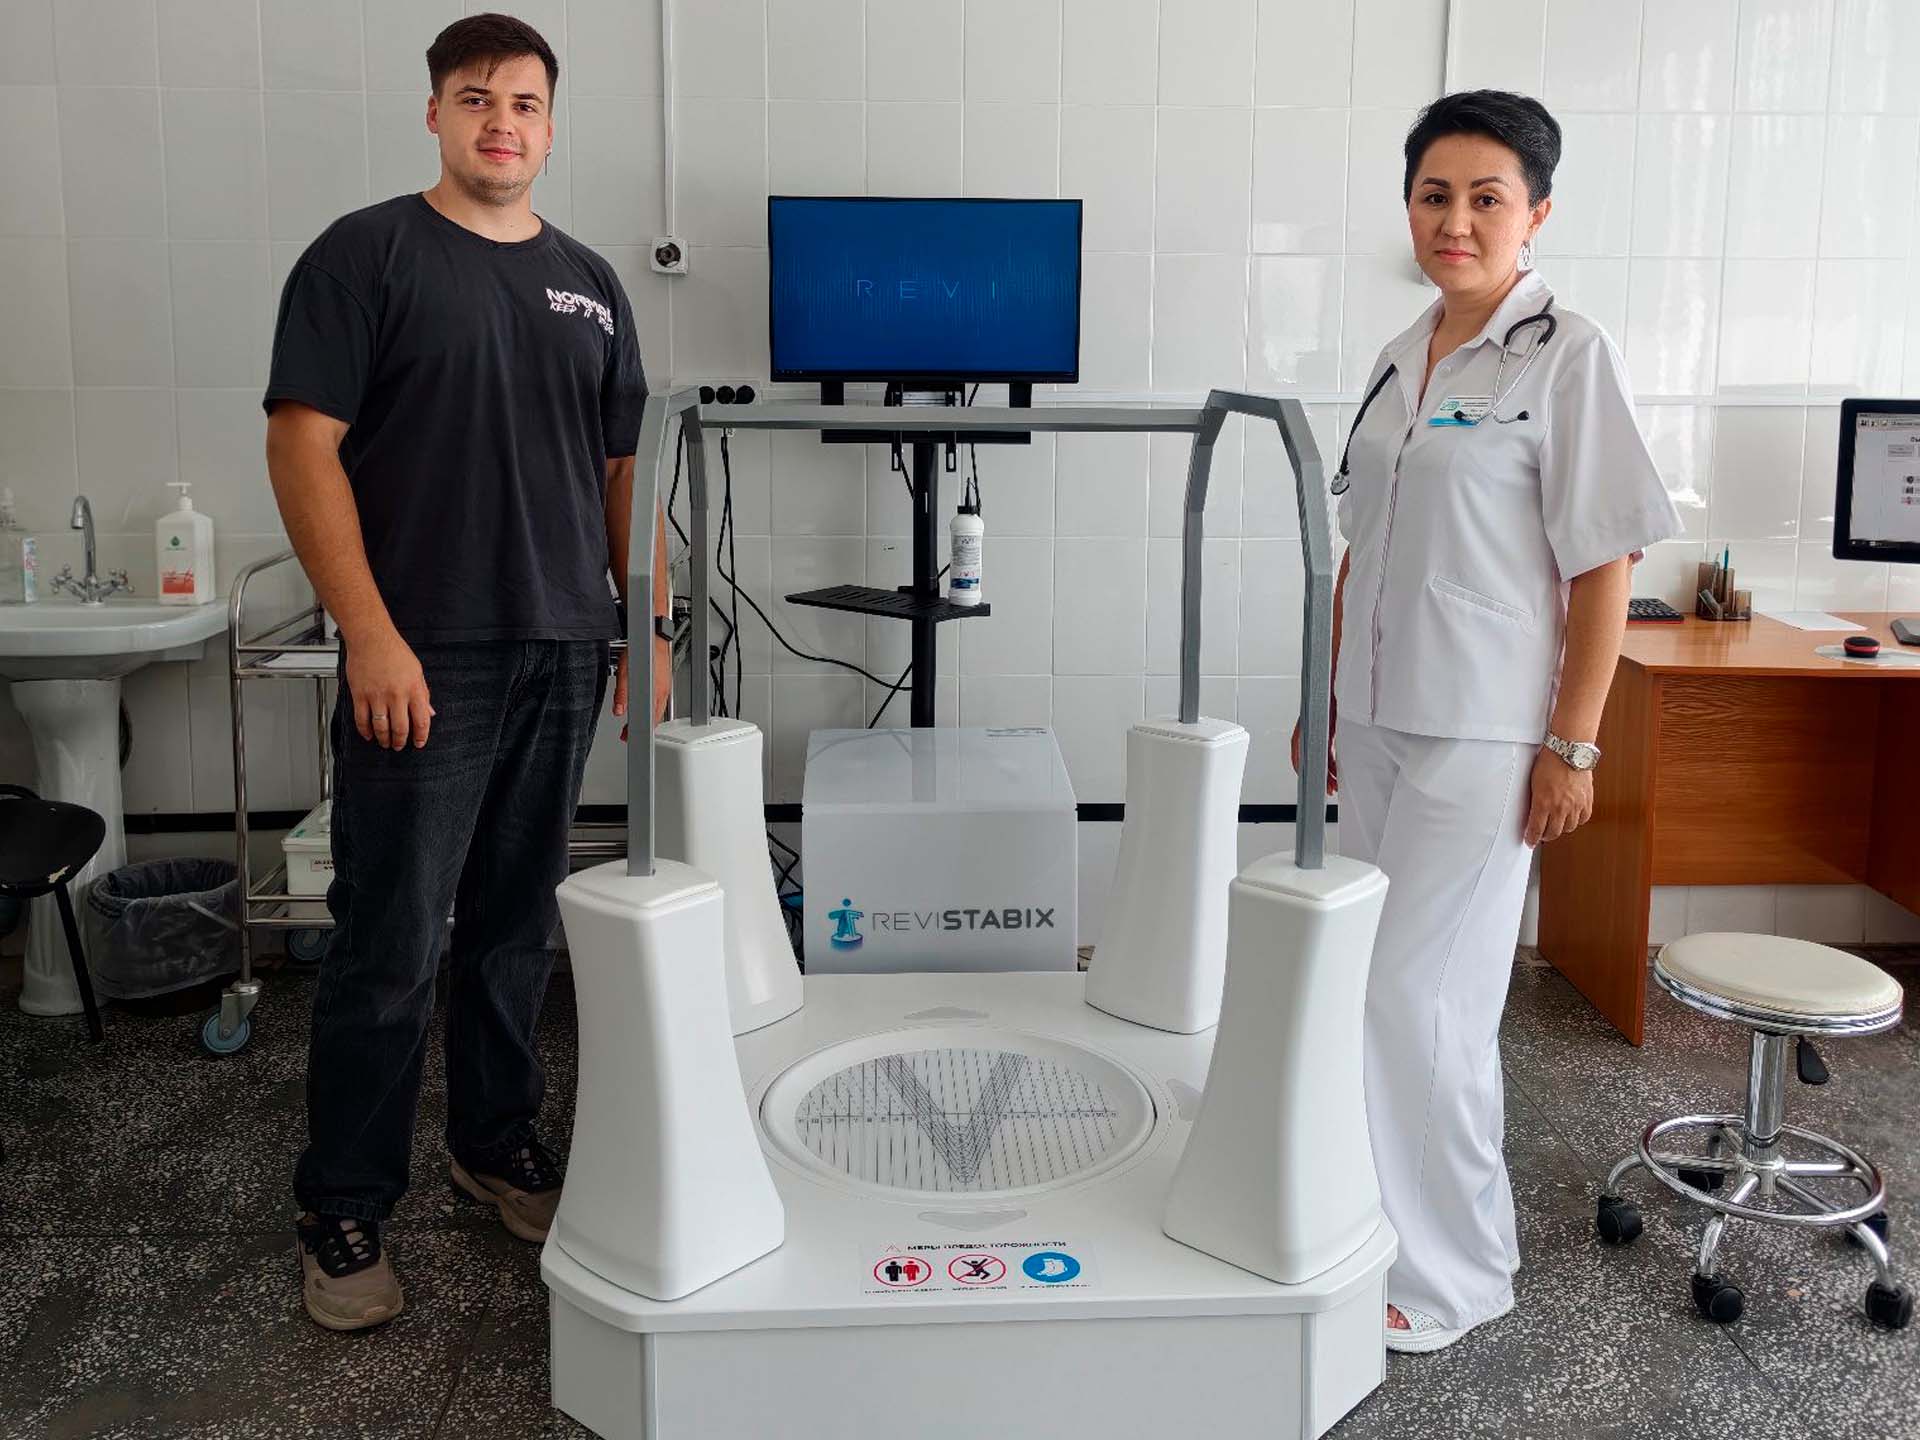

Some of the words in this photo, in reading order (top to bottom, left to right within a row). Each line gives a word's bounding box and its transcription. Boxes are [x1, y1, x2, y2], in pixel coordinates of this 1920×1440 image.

[856, 279, 996, 299] REVI
[545, 287, 613, 324] NORMAL
[872, 908, 1055, 931] REVISTABIX
